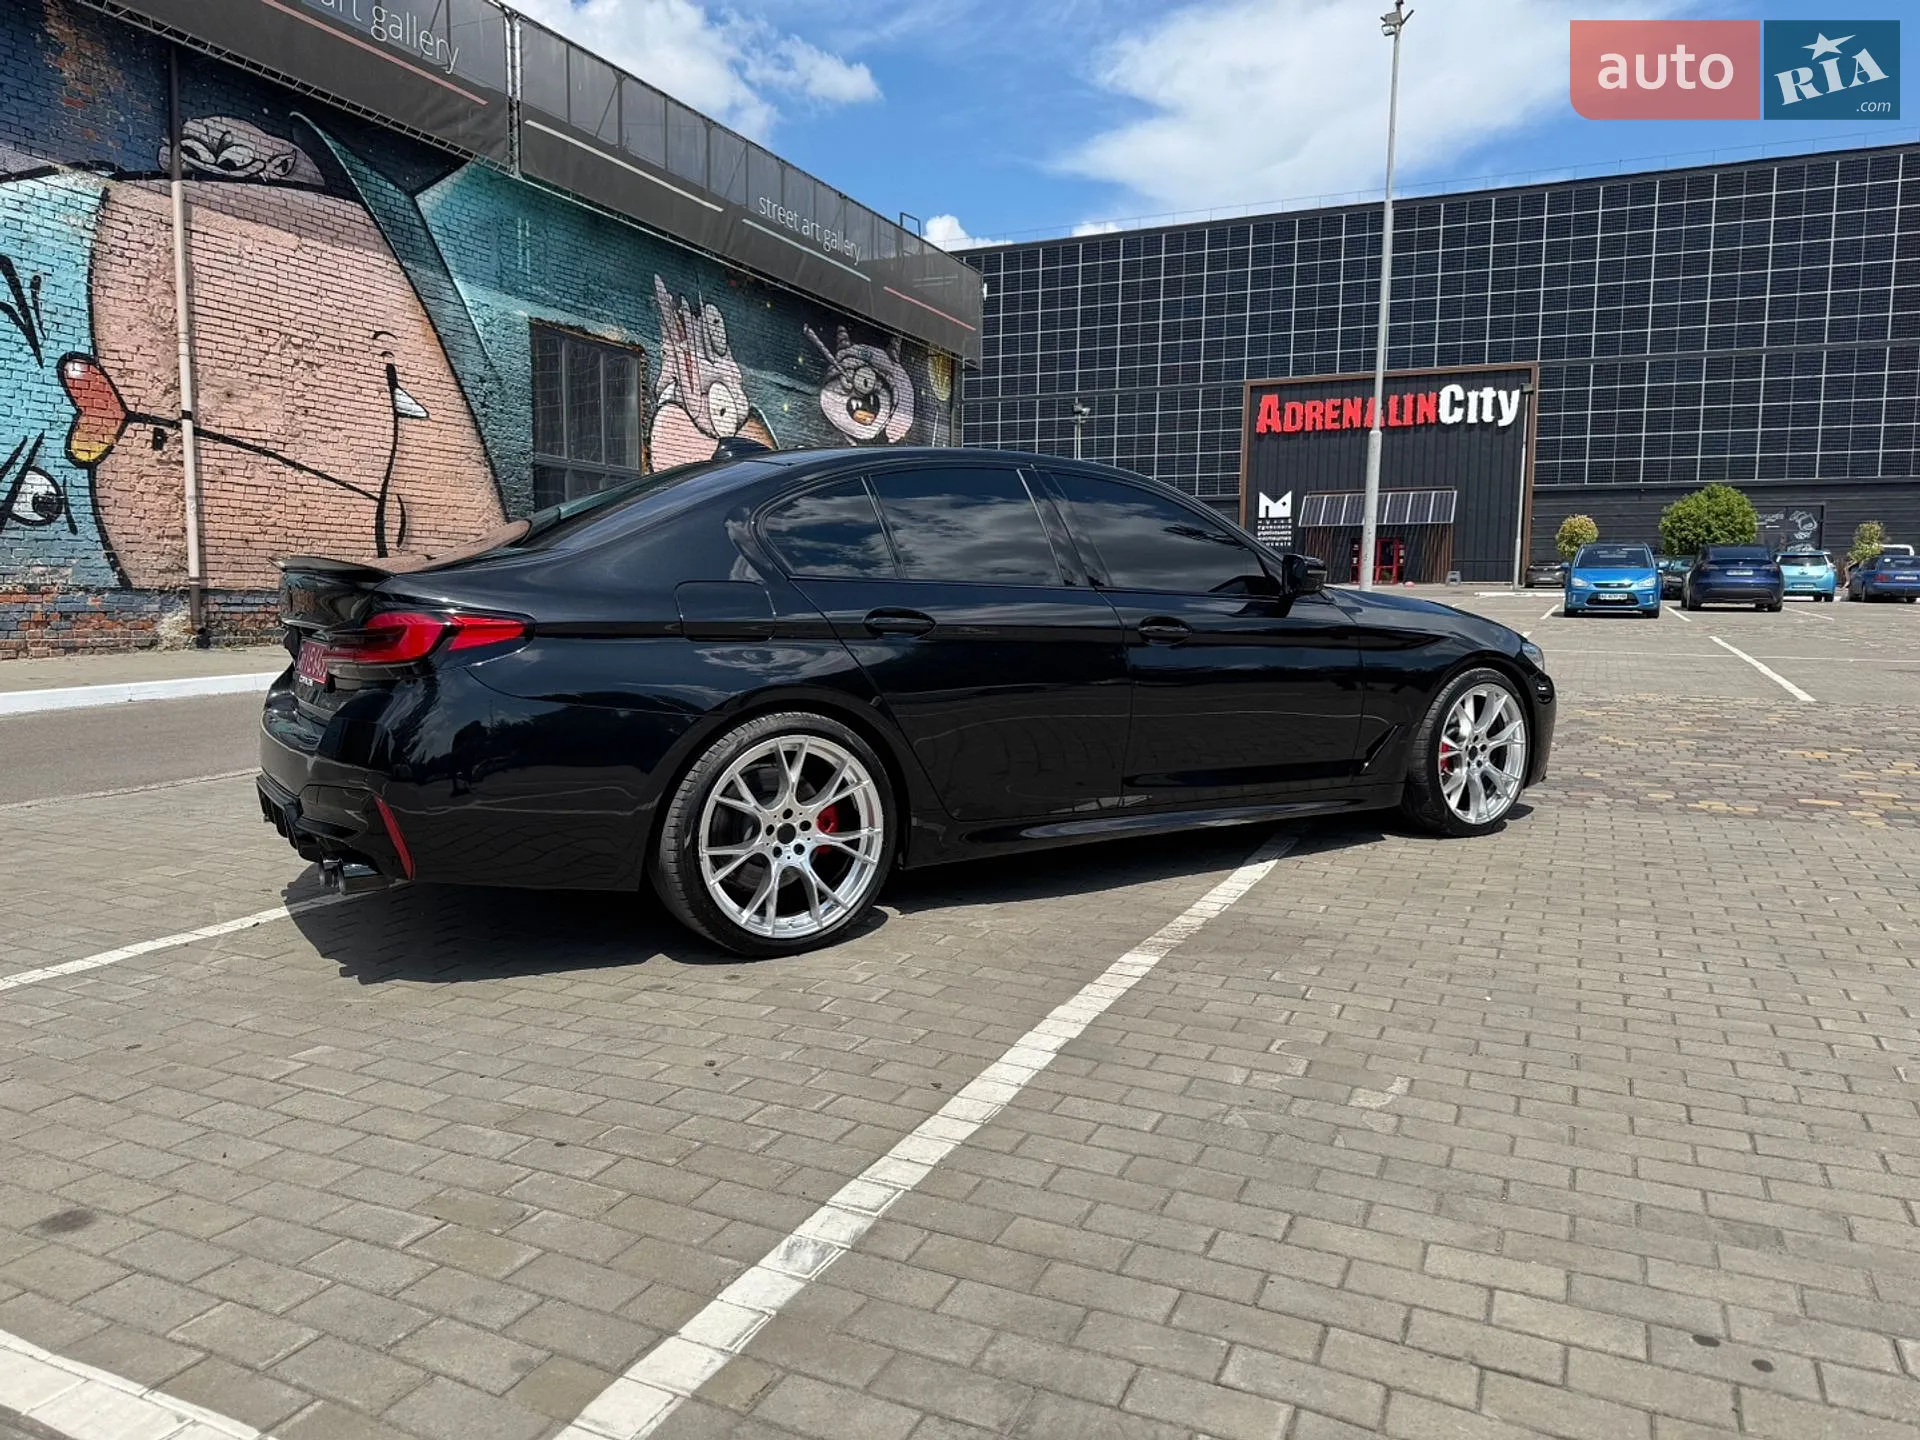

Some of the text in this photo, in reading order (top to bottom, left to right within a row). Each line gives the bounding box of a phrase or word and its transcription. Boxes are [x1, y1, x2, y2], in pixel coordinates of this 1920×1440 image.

[370, 5, 459, 74] gallery
[759, 197, 861, 266] street art gallery
